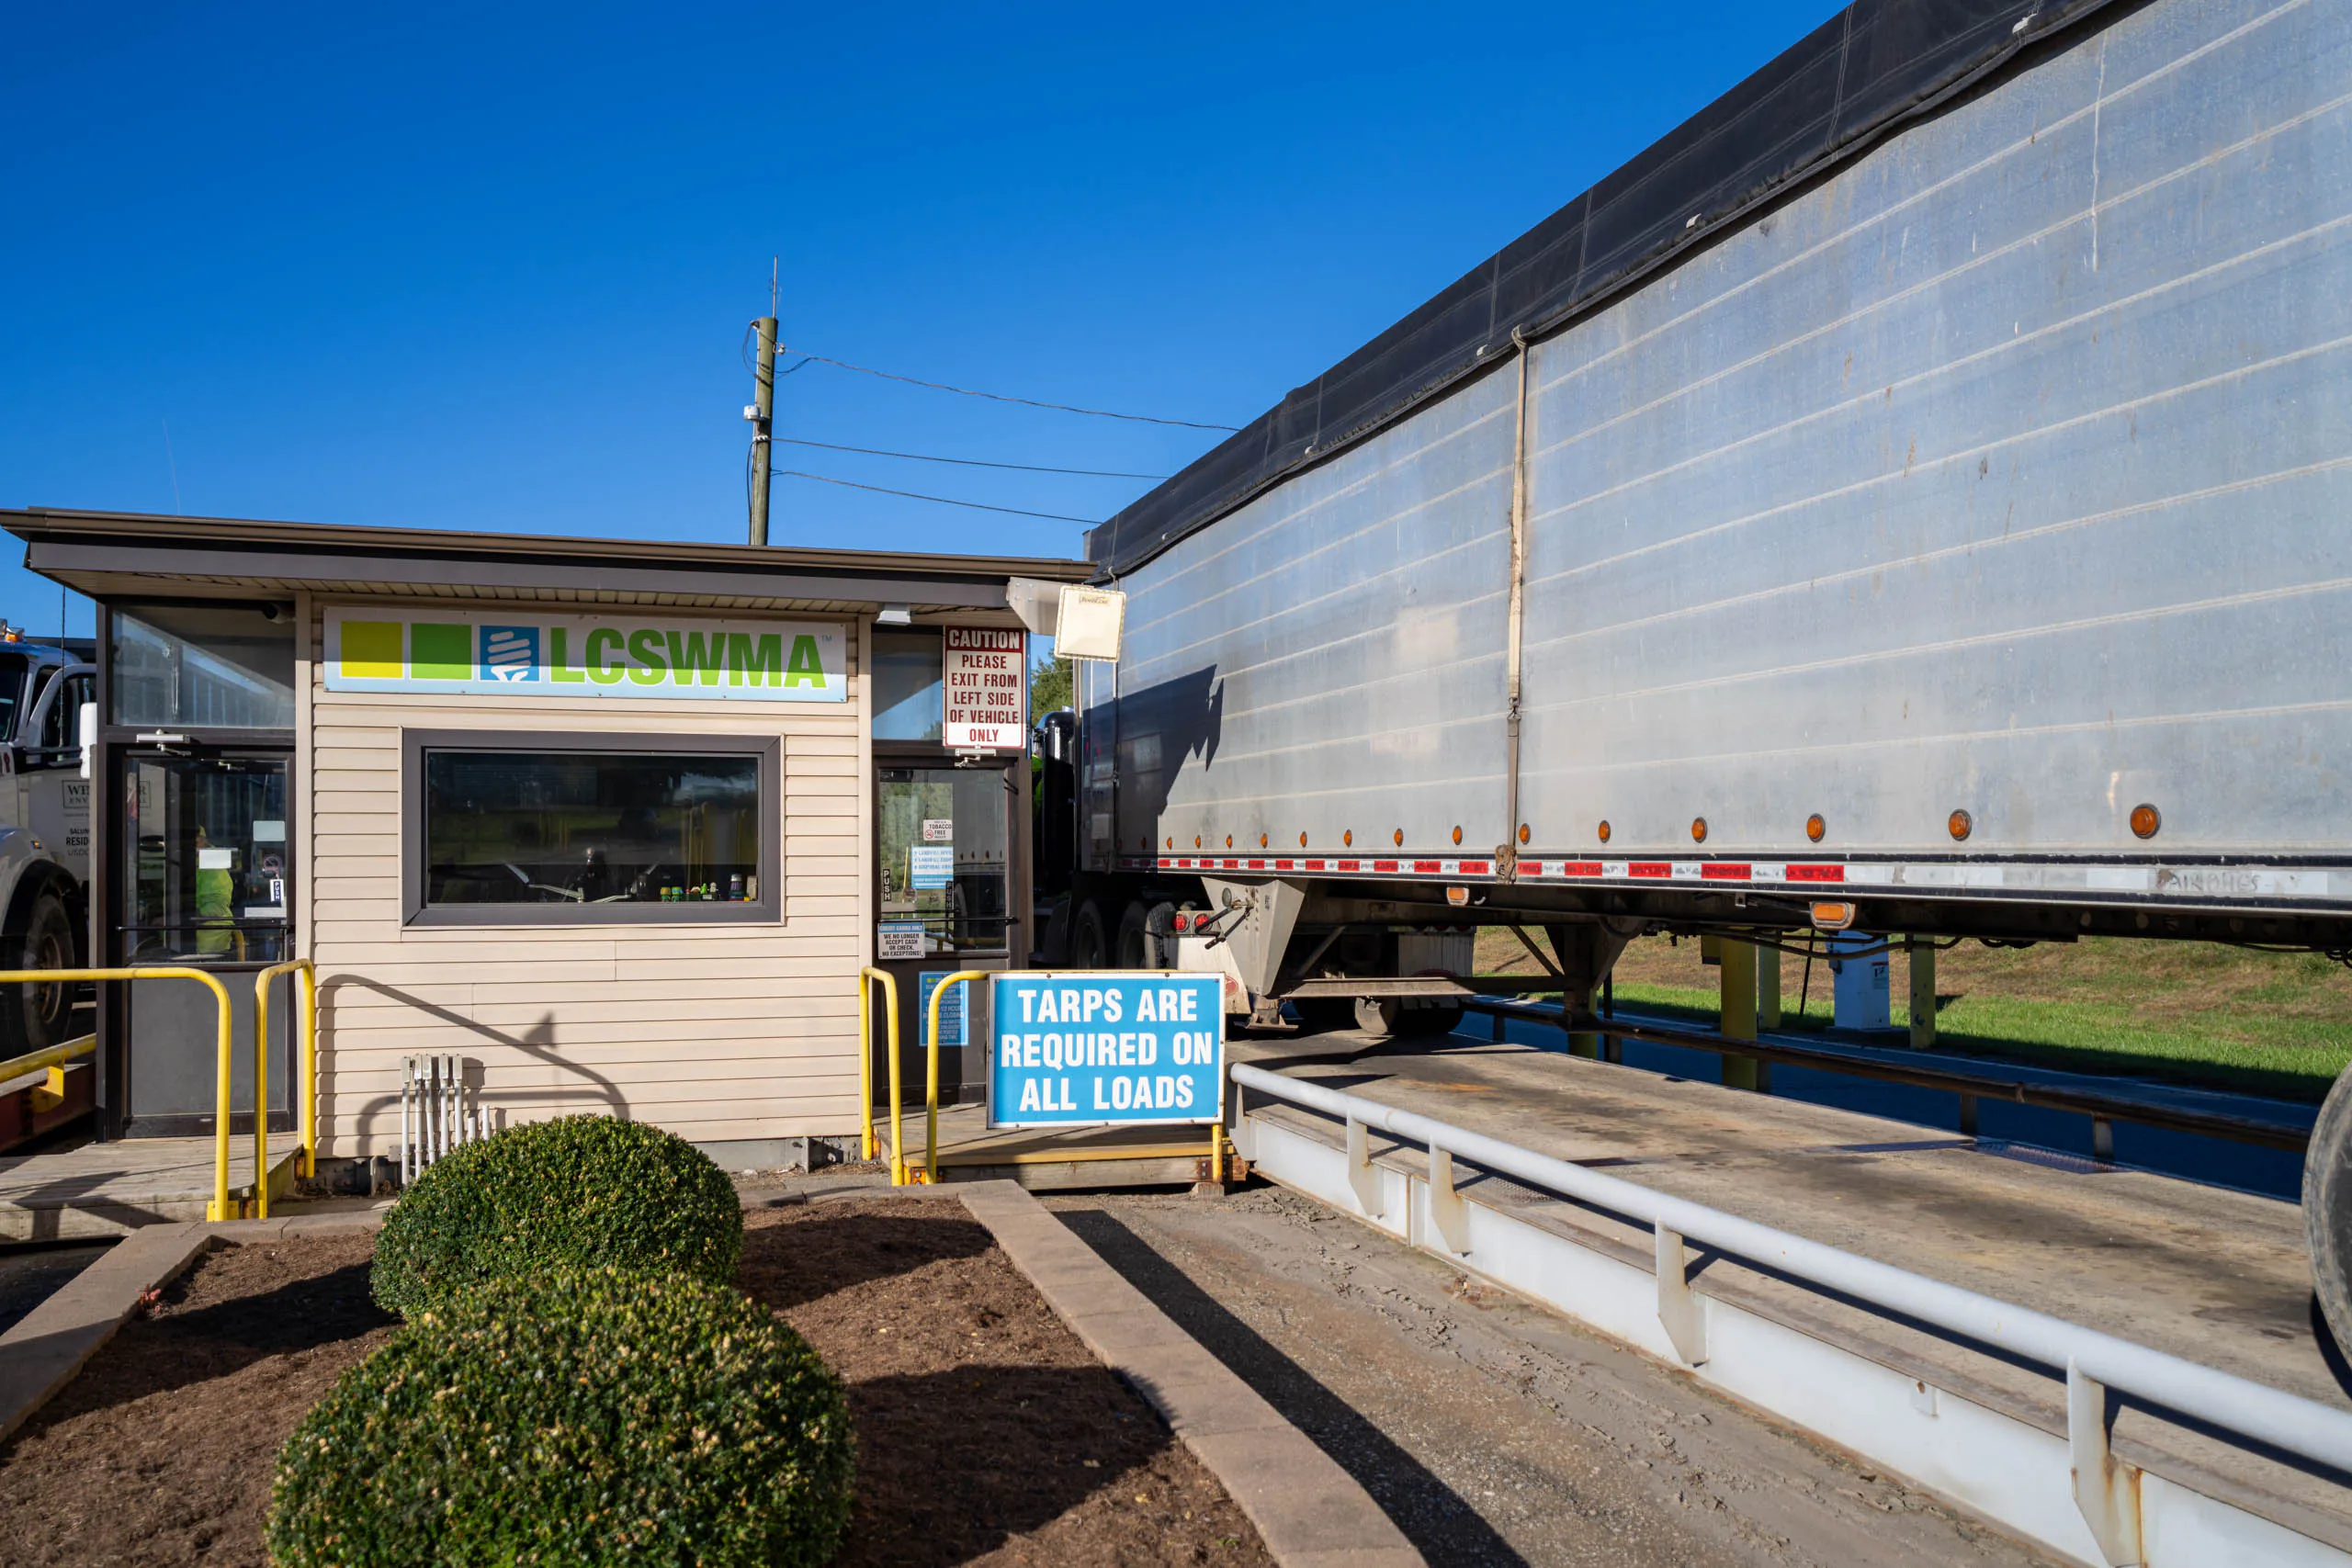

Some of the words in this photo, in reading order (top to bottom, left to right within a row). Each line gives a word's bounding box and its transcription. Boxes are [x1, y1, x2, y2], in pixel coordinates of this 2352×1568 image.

[949, 629, 1020, 649] CAUTION
[549, 627, 828, 689] LCSWMA
[962, 654, 1007, 669] PLEASE
[952, 672, 978, 686] EXIT
[984, 674, 1017, 687] FROM
[954, 691, 981, 705] LEFT
[988, 692, 1014, 705] SIDE
[950, 709, 964, 723] OF
[970, 710, 1018, 724] VEHICLE
[969, 728, 999, 742] ONLY
[66, 836, 89, 846] RESID
[1017, 988, 1123, 1023] TARPS
[1136, 988, 1198, 1022] ARE
[1001, 1032, 1158, 1071] REQUIRED
[1172, 1032, 1213, 1066] ON
[1019, 1077, 1077, 1112] ALL
[1093, 1075, 1194, 1111] LOADS
